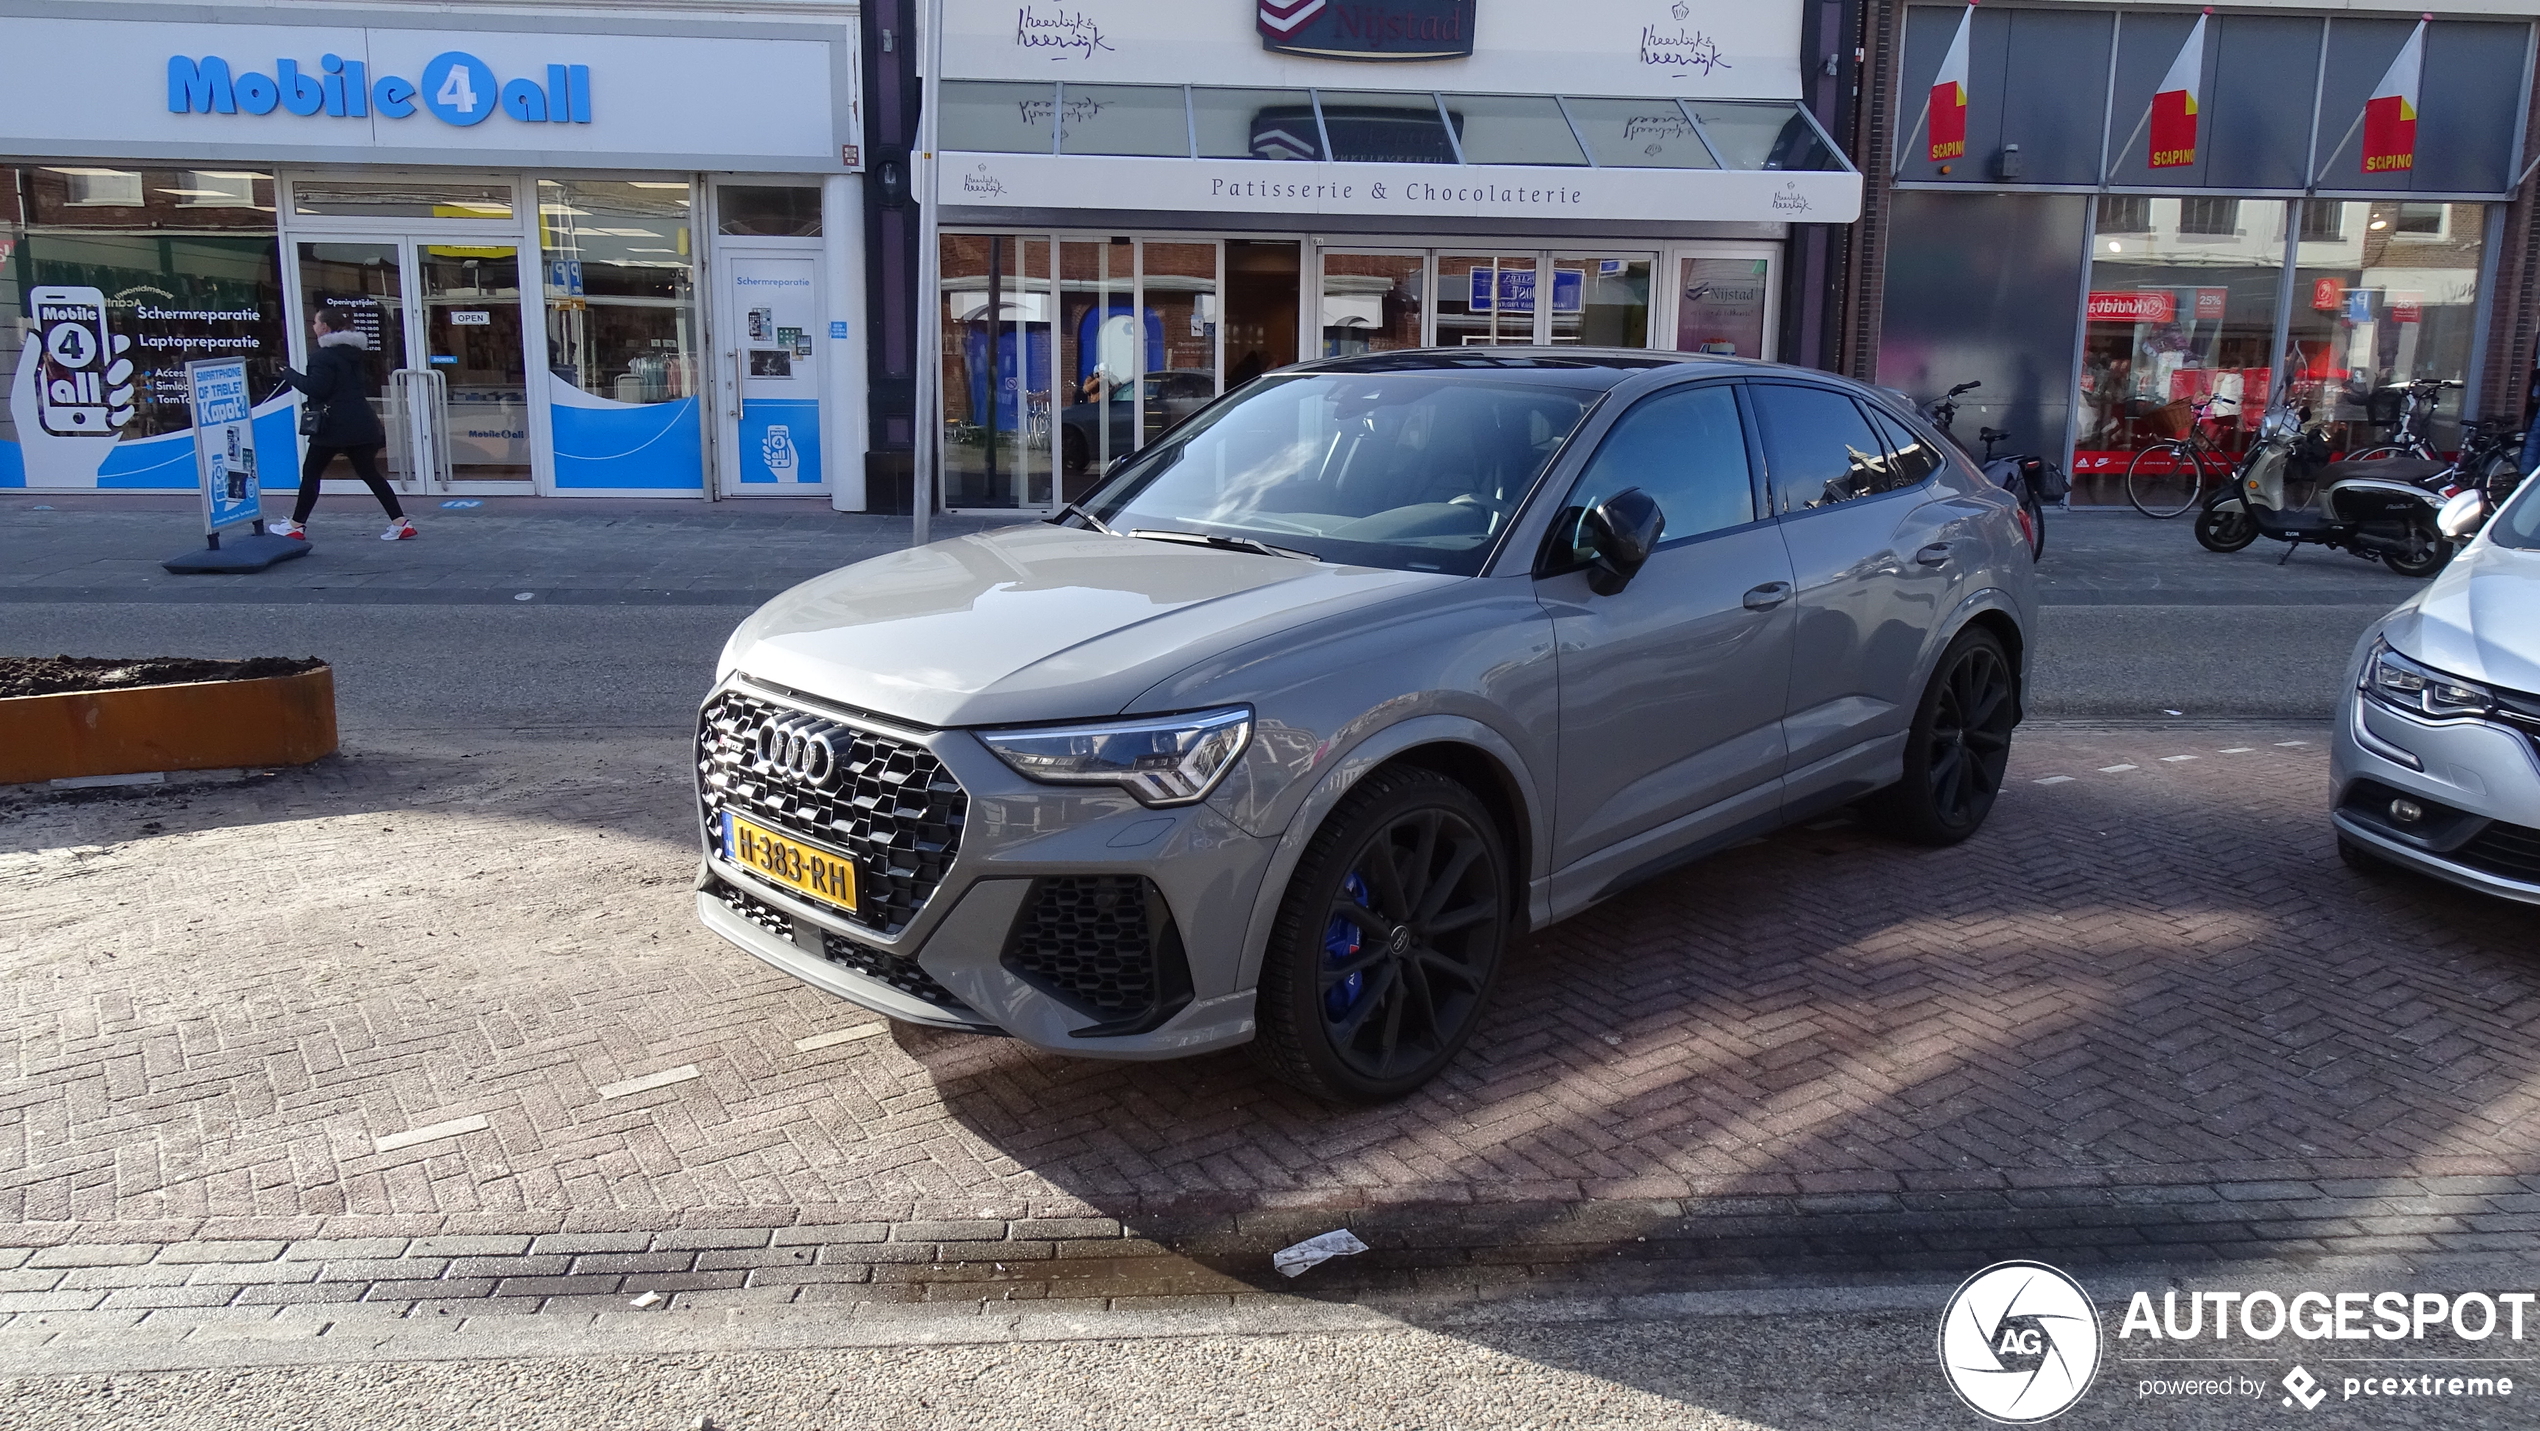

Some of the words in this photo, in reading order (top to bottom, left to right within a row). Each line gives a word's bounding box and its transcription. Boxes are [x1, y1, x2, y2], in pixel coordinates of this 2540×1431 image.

[1334, 4, 1461, 47] Nijstad
[1211, 178, 1353, 200] Patisserie
[1371, 182, 1388, 200] &
[1406, 182, 1582, 204] Chocolaterie
[736, 277, 810, 287] Schermreparatie
[326, 298, 378, 307] Openingstijden
[1711, 287, 1754, 303] Nijstad
[2199, 295, 2222, 305] 25%
[43, 307, 97, 321] Mobile
[138, 306, 261, 325] Schermreparatie
[458, 314, 484, 322] OPEN
[58, 330, 84, 359] 4
[140, 335, 261, 353] Laptopreparatie
[155, 367, 187, 377] Access
[196, 367, 241, 382] SMARTPHONE
[50, 372, 101, 404] all
[198, 386, 209, 399] OF
[211, 381, 243, 397] TABLET
[157, 393, 191, 404] TomTo
[739, 825, 847, 901] H-383-RH
